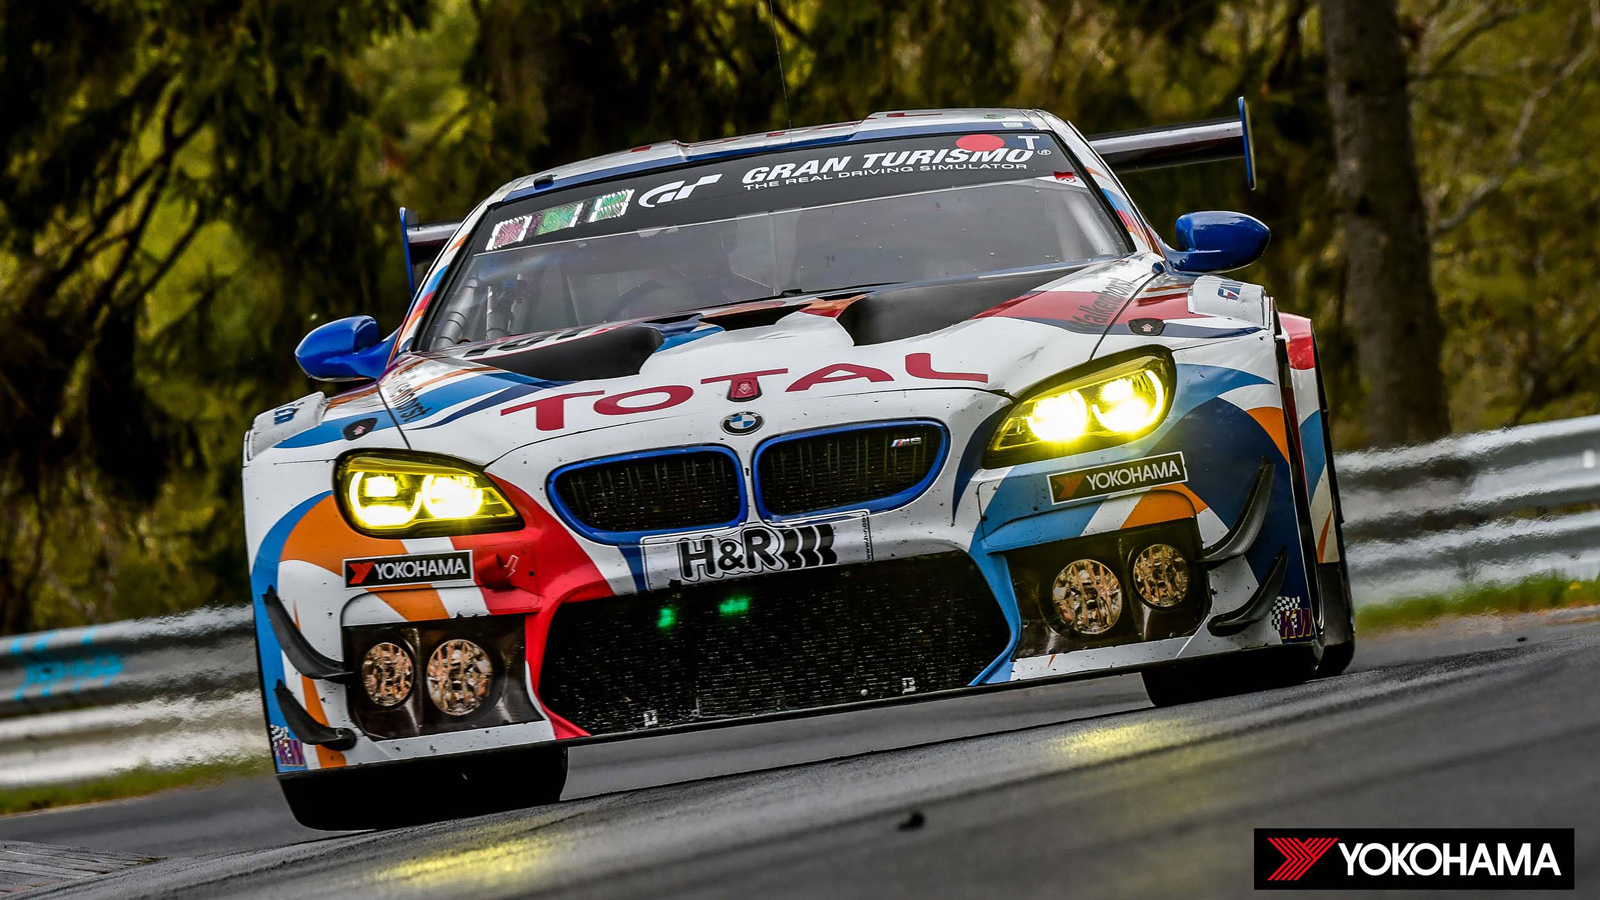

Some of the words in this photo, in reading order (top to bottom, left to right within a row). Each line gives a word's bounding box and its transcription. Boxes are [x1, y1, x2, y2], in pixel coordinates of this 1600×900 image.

[741, 155, 853, 184] GRAN
[861, 148, 1035, 169] TURISMO
[743, 180, 780, 191] THE
[785, 173, 834, 186] REAL
[838, 166, 914, 179] DRIVING
[919, 163, 1028, 172] SIMULATOR
[500, 351, 990, 431] TOTAL
[1085, 460, 1181, 491] YOKOHAMA
[374, 558, 467, 580] YOKOHAMA
[677, 526, 779, 581] H&R
